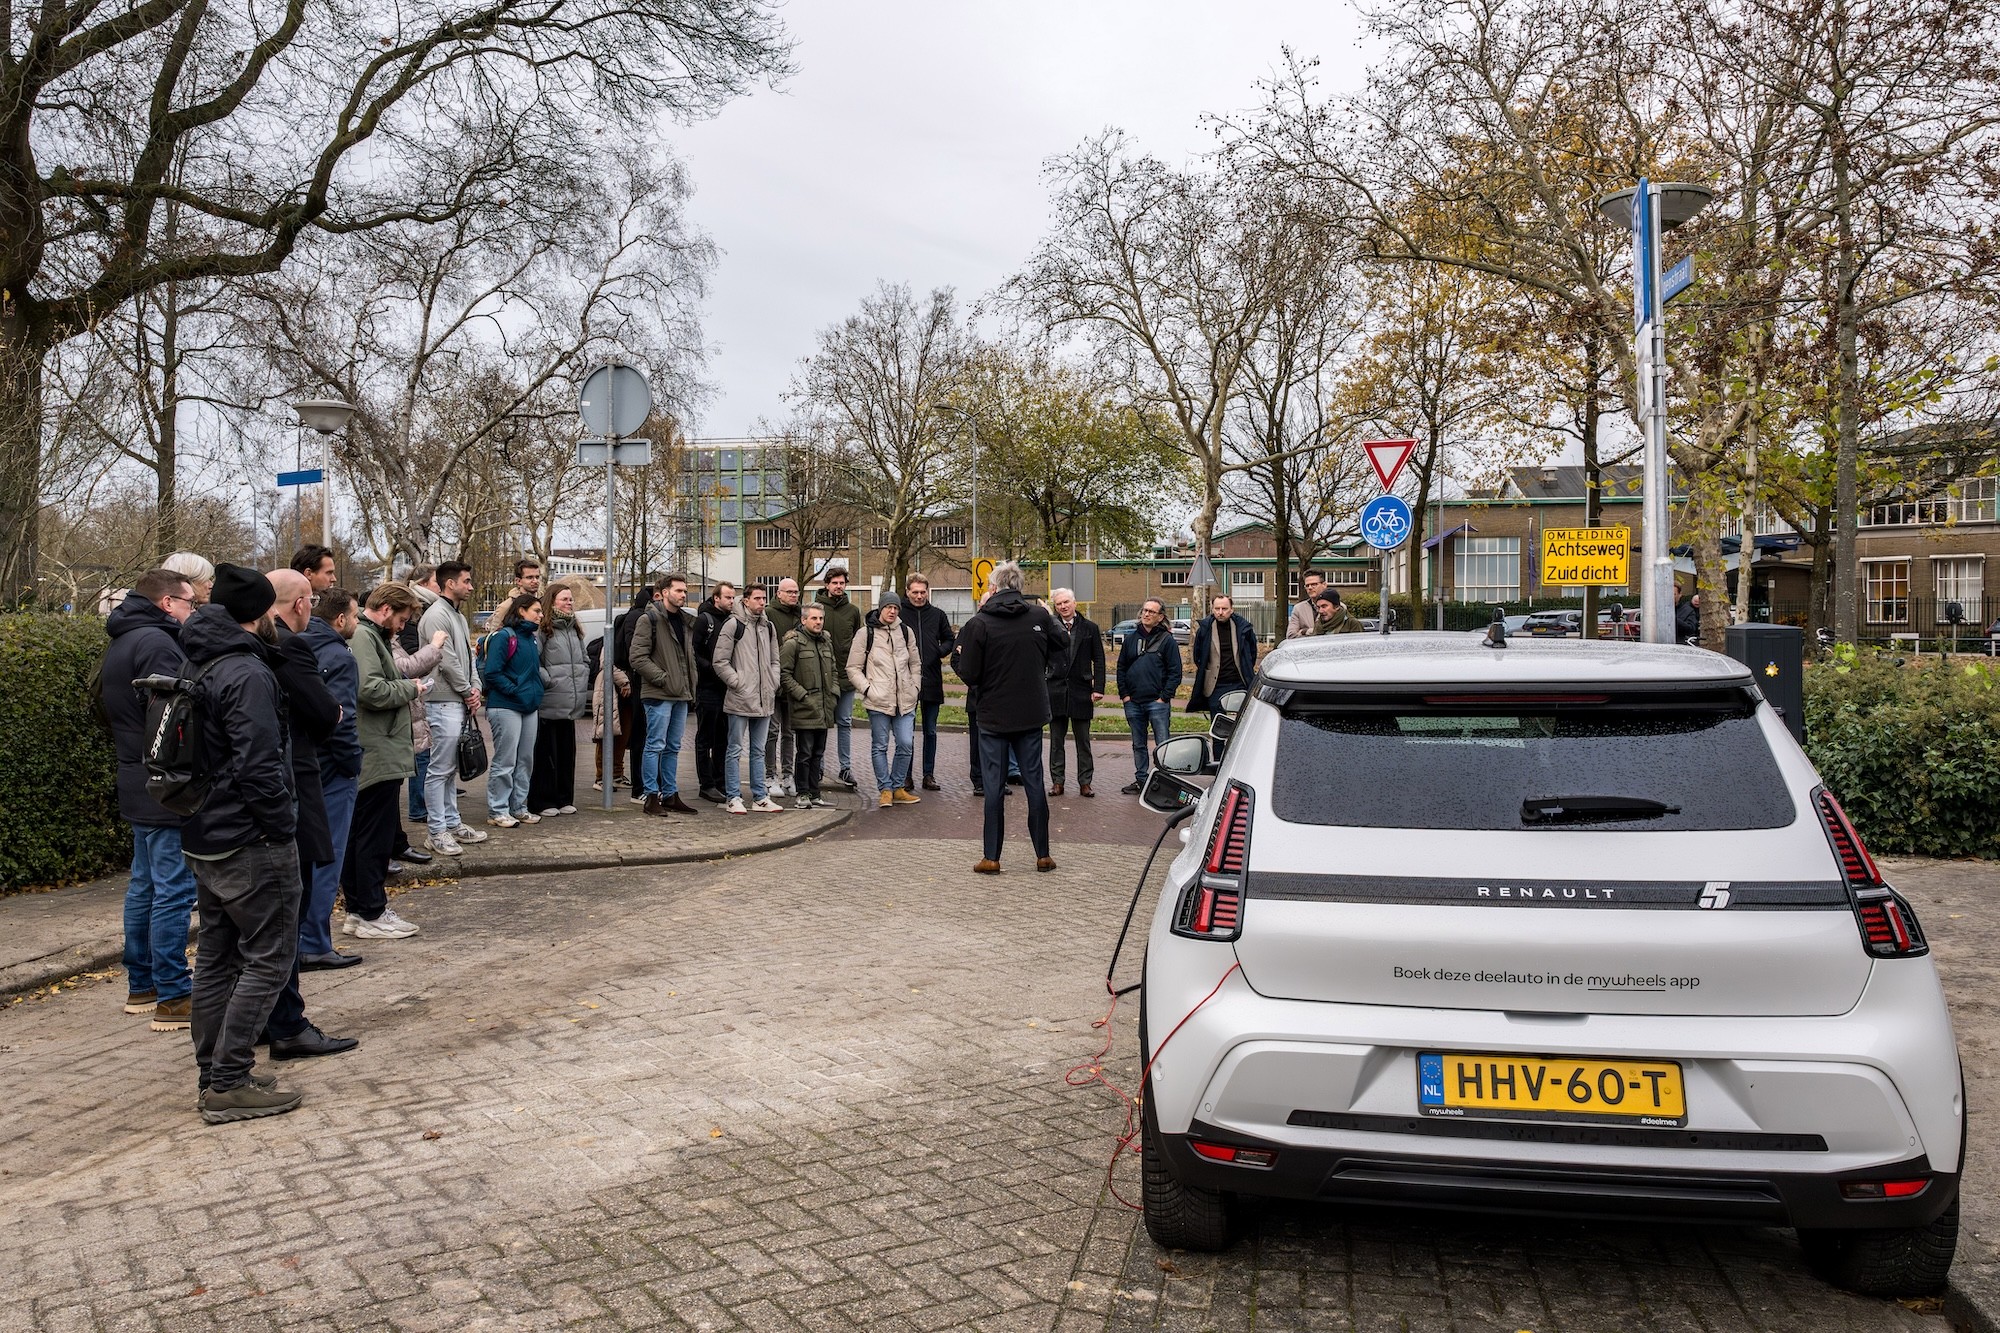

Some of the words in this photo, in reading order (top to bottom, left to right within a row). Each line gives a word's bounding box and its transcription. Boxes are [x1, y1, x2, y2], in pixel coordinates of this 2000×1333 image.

[1547, 530, 1624, 540] OMLEIDING
[1546, 542, 1625, 560] Achtseweg
[1547, 565, 1578, 580] Zuid
[1581, 565, 1619, 580] dicht
[150, 702, 172, 759] DAINESE
[1477, 886, 1615, 899] RENAULT
[1698, 881, 1731, 910] 5
[1393, 966, 1431, 980] Boek
[1433, 968, 1471, 981] deze
[1474, 970, 1543, 984] deelauto
[1546, 972, 1560, 985] in
[1563, 973, 1584, 985] de
[1587, 974, 1666, 988] mywheels
[1669, 976, 1700, 990] app
[1423, 1084, 1442, 1096] NL
[1457, 1062, 1667, 1107] HHV-60-T
[1428, 1108, 1464, 1116] mywheels
[1640, 1117, 1678, 1126] #deelmee
